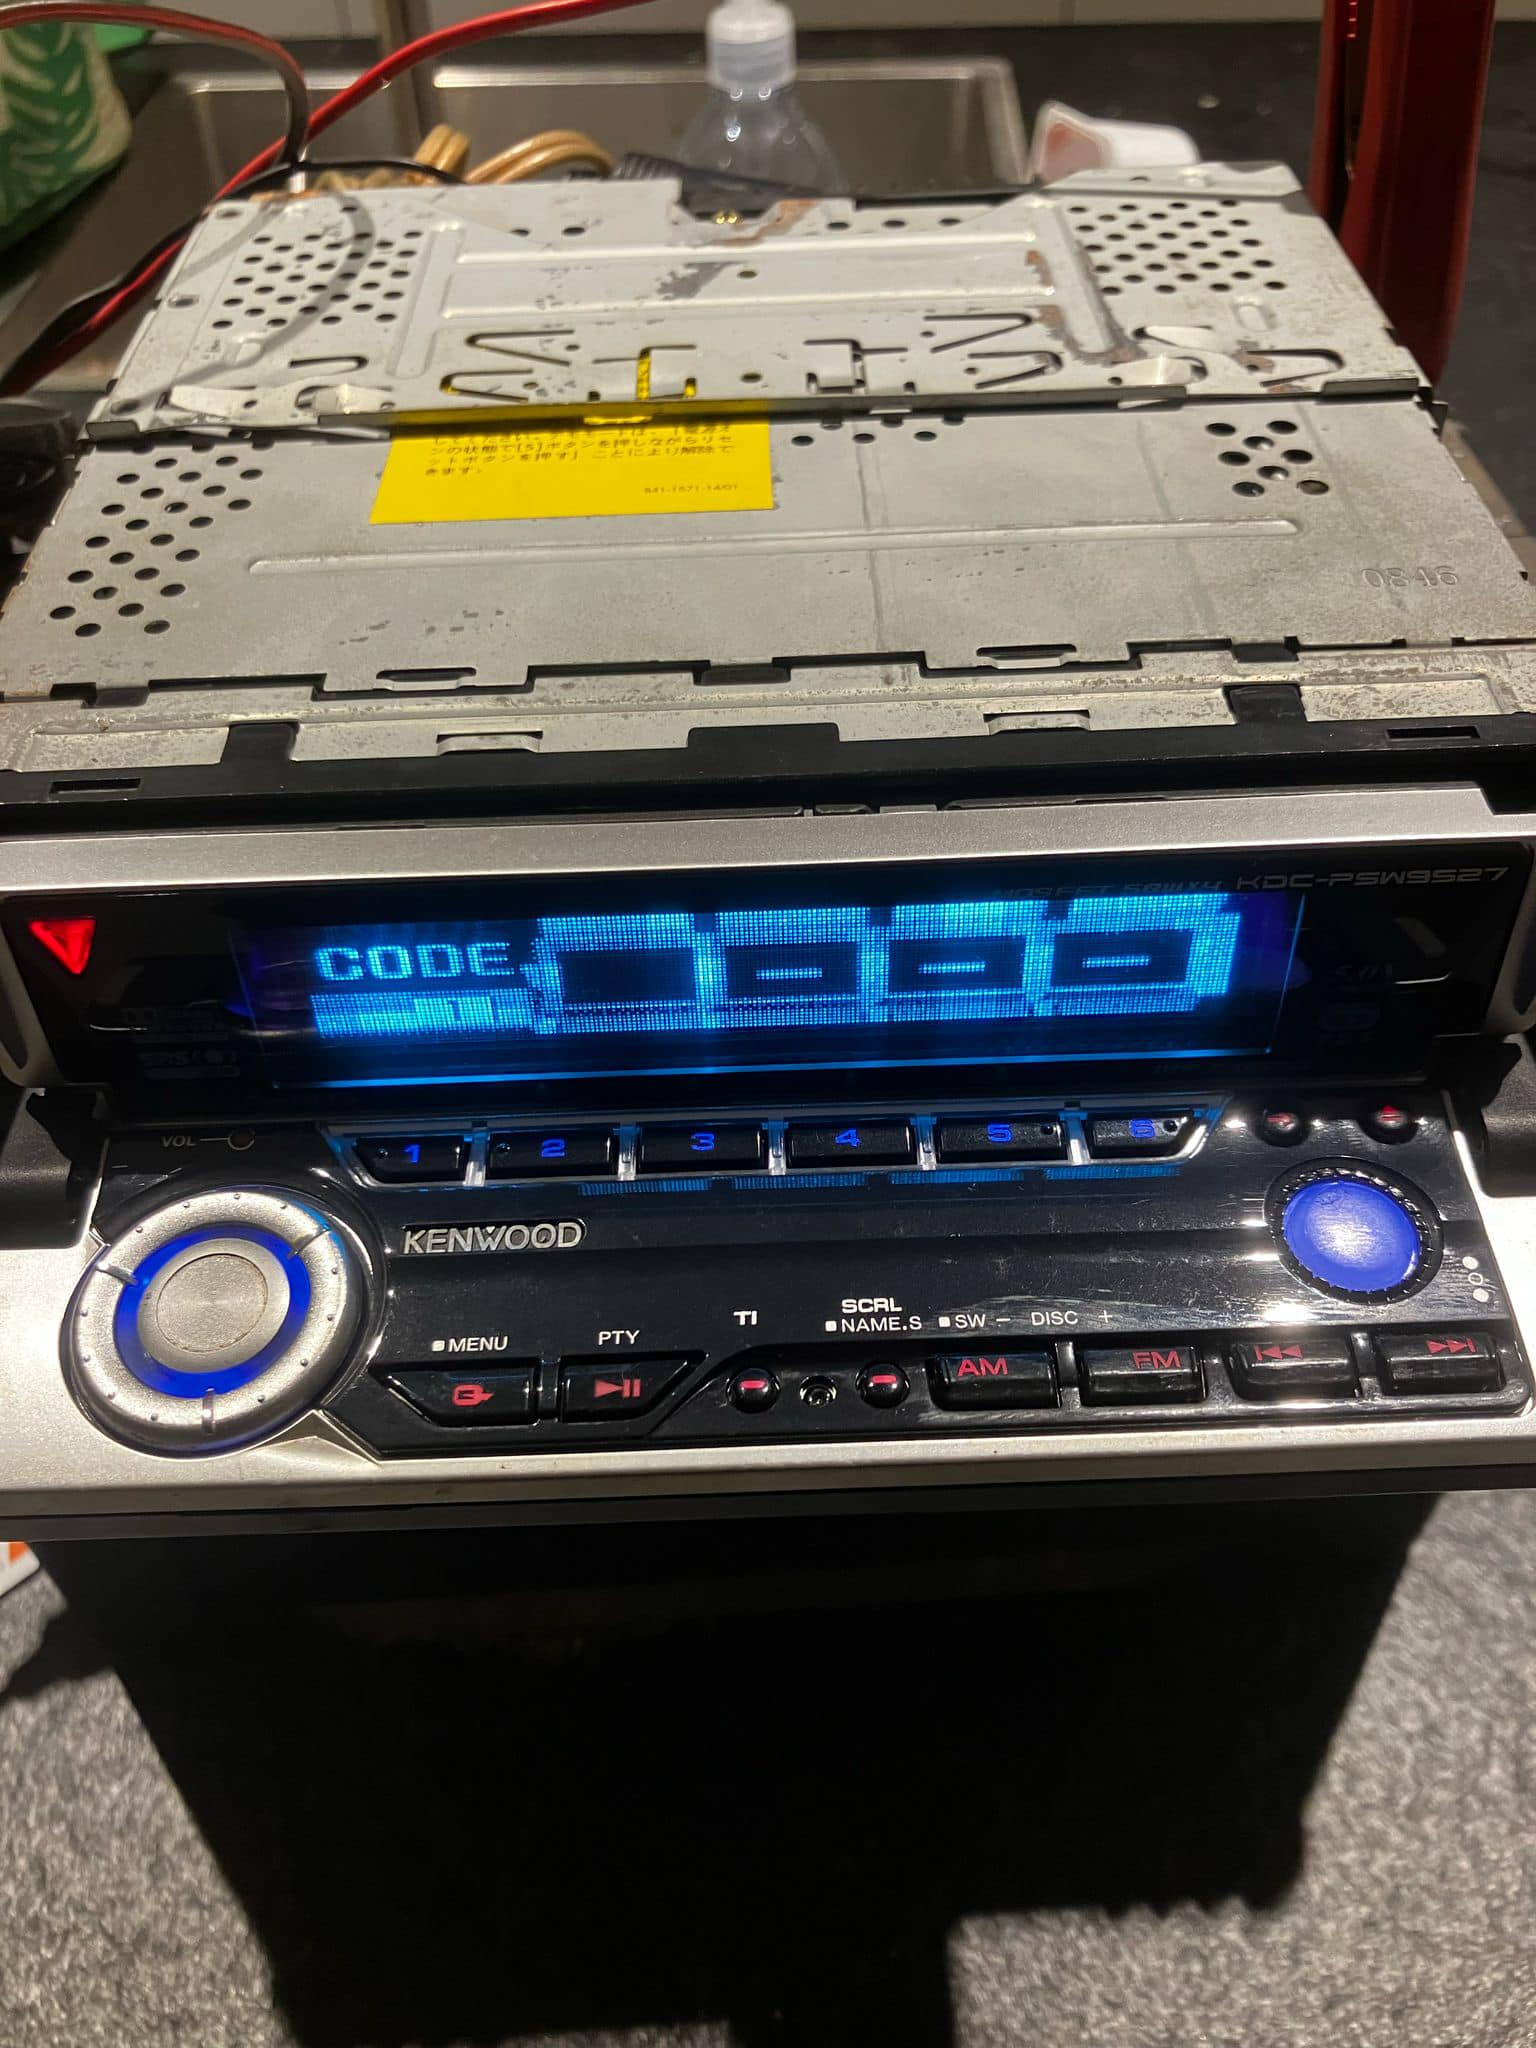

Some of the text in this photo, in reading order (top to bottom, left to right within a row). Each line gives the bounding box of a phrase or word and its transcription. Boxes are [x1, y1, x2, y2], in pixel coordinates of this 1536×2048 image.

[1236, 867, 1509, 891] KDC-PSW9527
[315, 941, 515, 981] CODE
[835, 1128, 861, 1149] 4
[987, 1124, 1012, 1143] 5
[1129, 1120, 1155, 1138] 6
[162, 1135, 196, 1148] VOL
[541, 1139, 566, 1158] 2
[690, 1132, 715, 1151] 3
[405, 1144, 421, 1164] 1
[403, 1222, 583, 1255] KENWOOD
[841, 1298, 902, 1313] SCRL
[733, 1310, 758, 1326] TI
[955, 1312, 986, 1329] SW
[1031, 1311, 1079, 1326] DISC
[448, 1335, 508, 1352] MENU
[598, 1329, 640, 1345] PTY
[957, 1357, 1009, 1377] AM
[1132, 1350, 1182, 1369] FM
